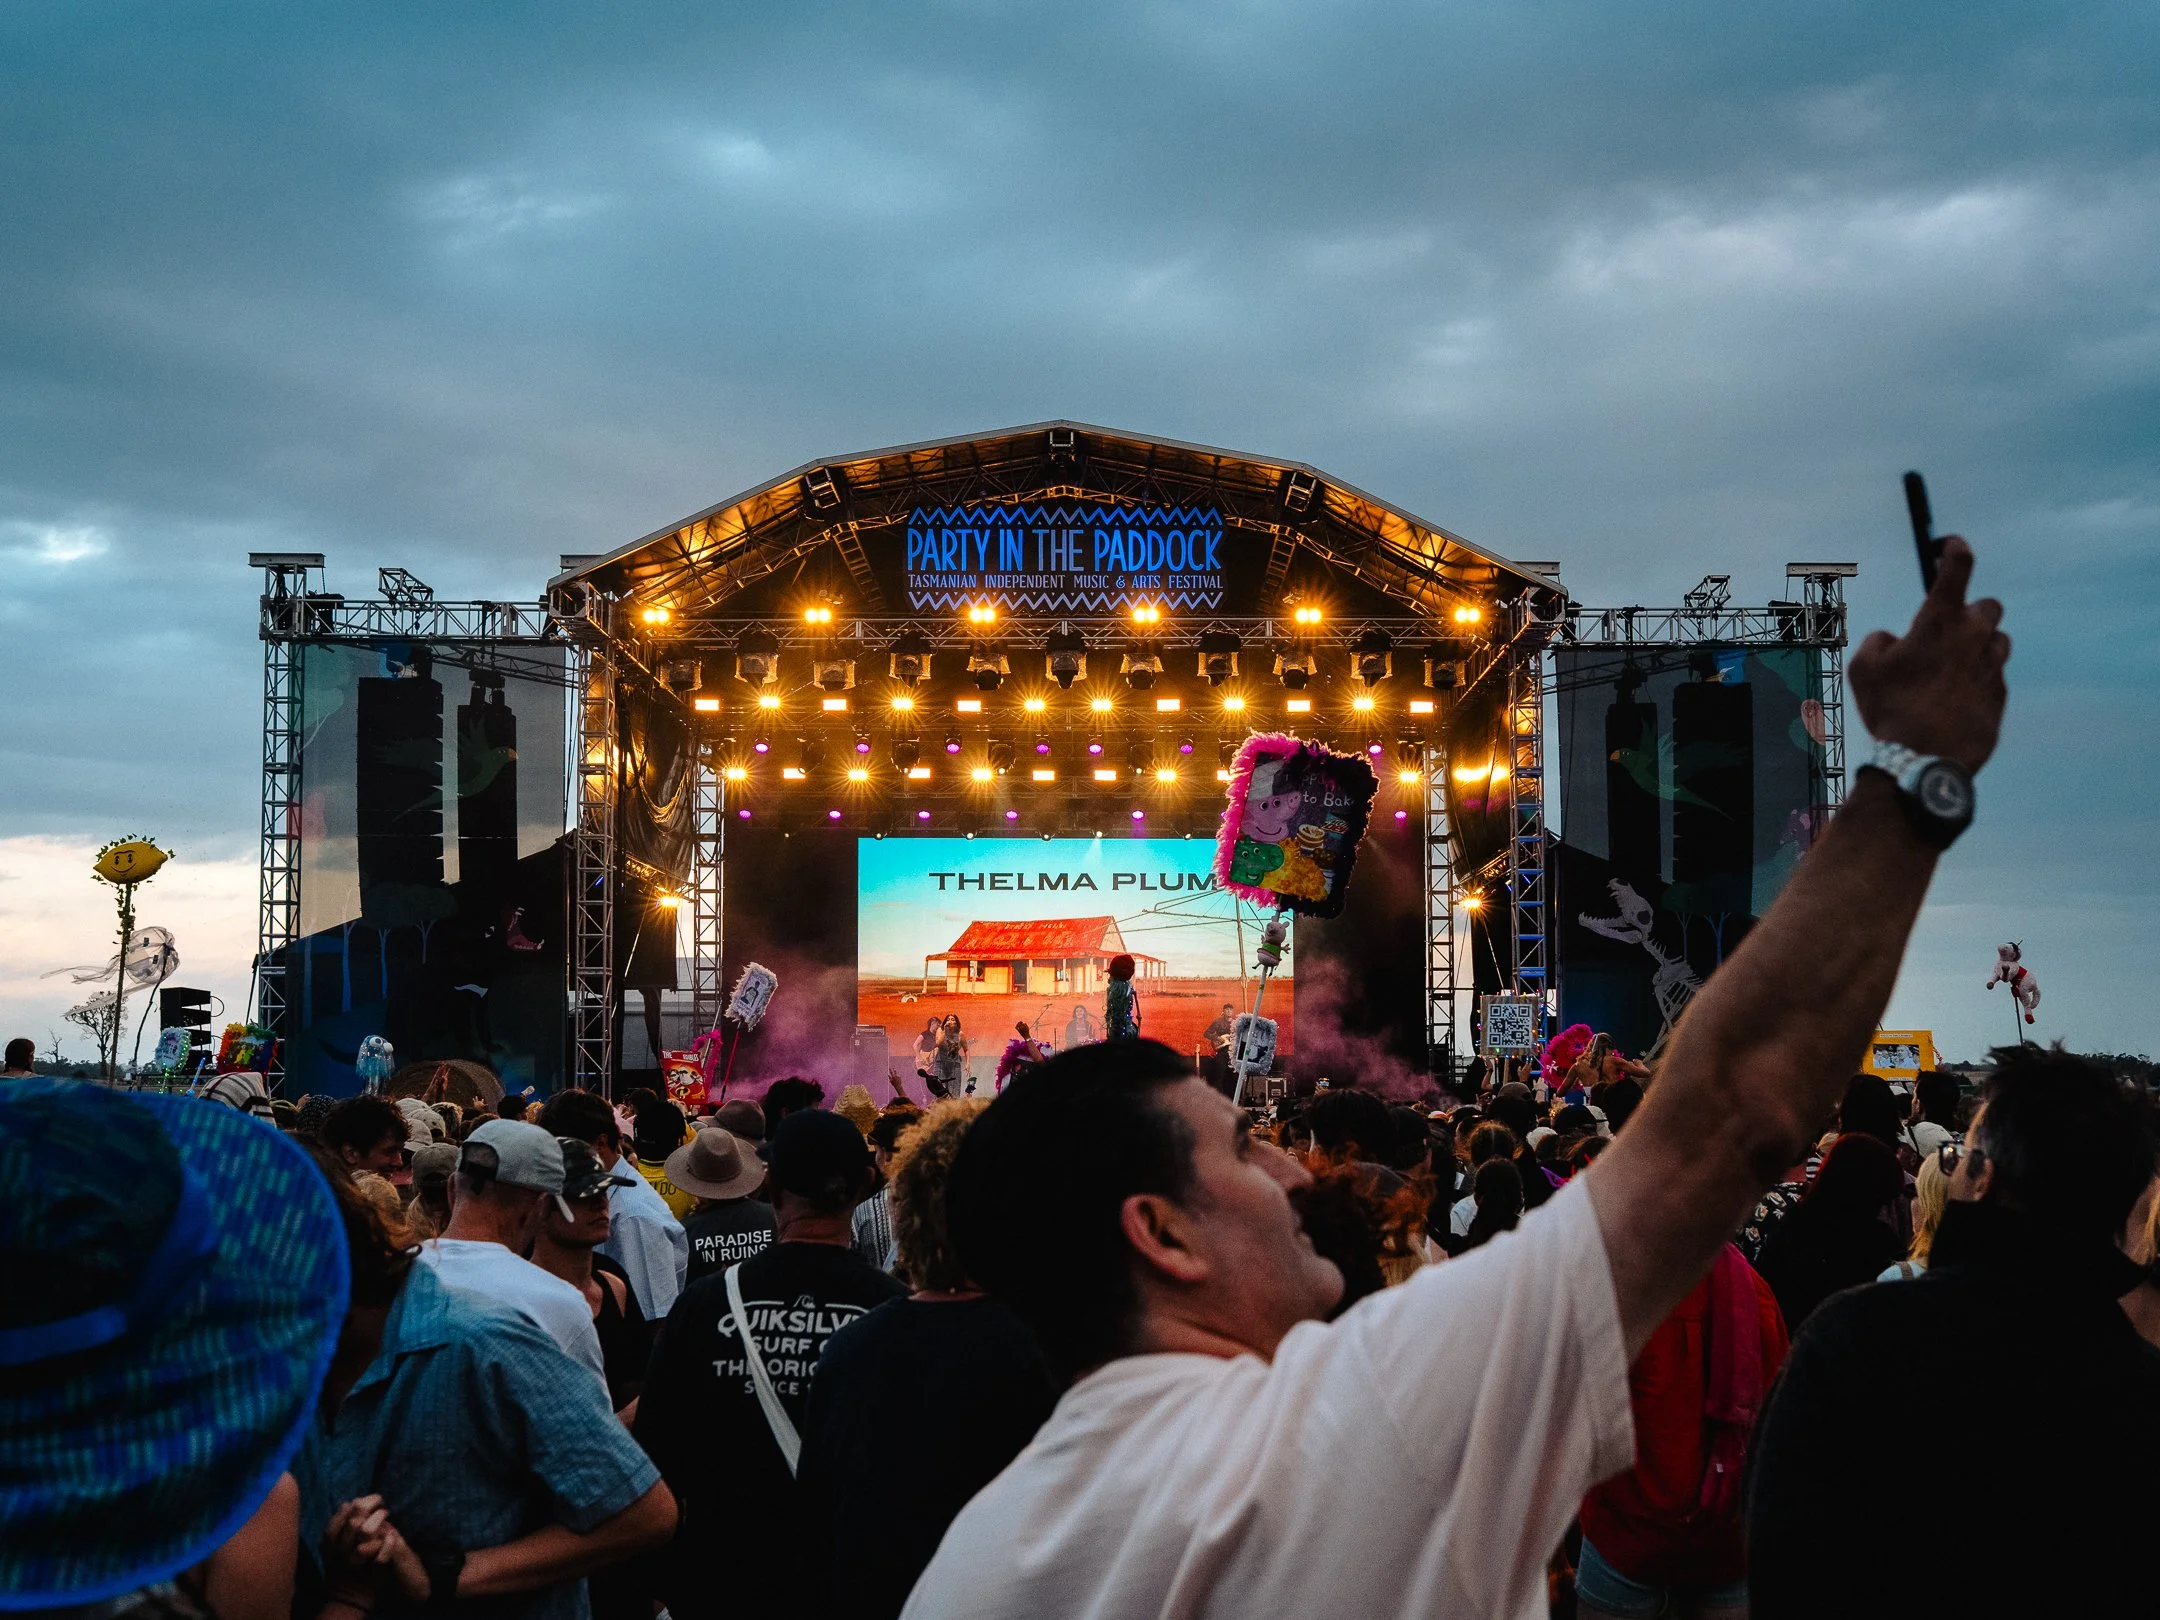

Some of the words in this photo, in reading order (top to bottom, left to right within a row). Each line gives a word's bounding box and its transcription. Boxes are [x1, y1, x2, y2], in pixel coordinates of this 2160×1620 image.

[907, 528, 991, 571] PARTY
[1000, 529, 1023, 571] IN
[1032, 529, 1084, 571] THE
[1094, 529, 1223, 571] PADDOCK
[908, 574, 977, 588] TASMANIAN
[985, 574, 1066, 588] INDEPENDENT
[1073, 575, 1109, 588] MUSIC
[1115, 575, 1126, 589] &
[1131, 575, 1161, 588] ARTS
[1168, 575, 1224, 588] FESTIVAL
[1303, 791, 1317, 804] to
[1323, 792, 1354, 807] Bak
[929, 872, 1099, 891] THELMA
[1111, 872, 1218, 891] PLUM
[695, 1229, 772, 1251] PARADISE
[702, 1249, 716, 1262] IN
[717, 1309, 861, 1338] QUIKSILV
[750, 1336, 813, 1354] SURF
